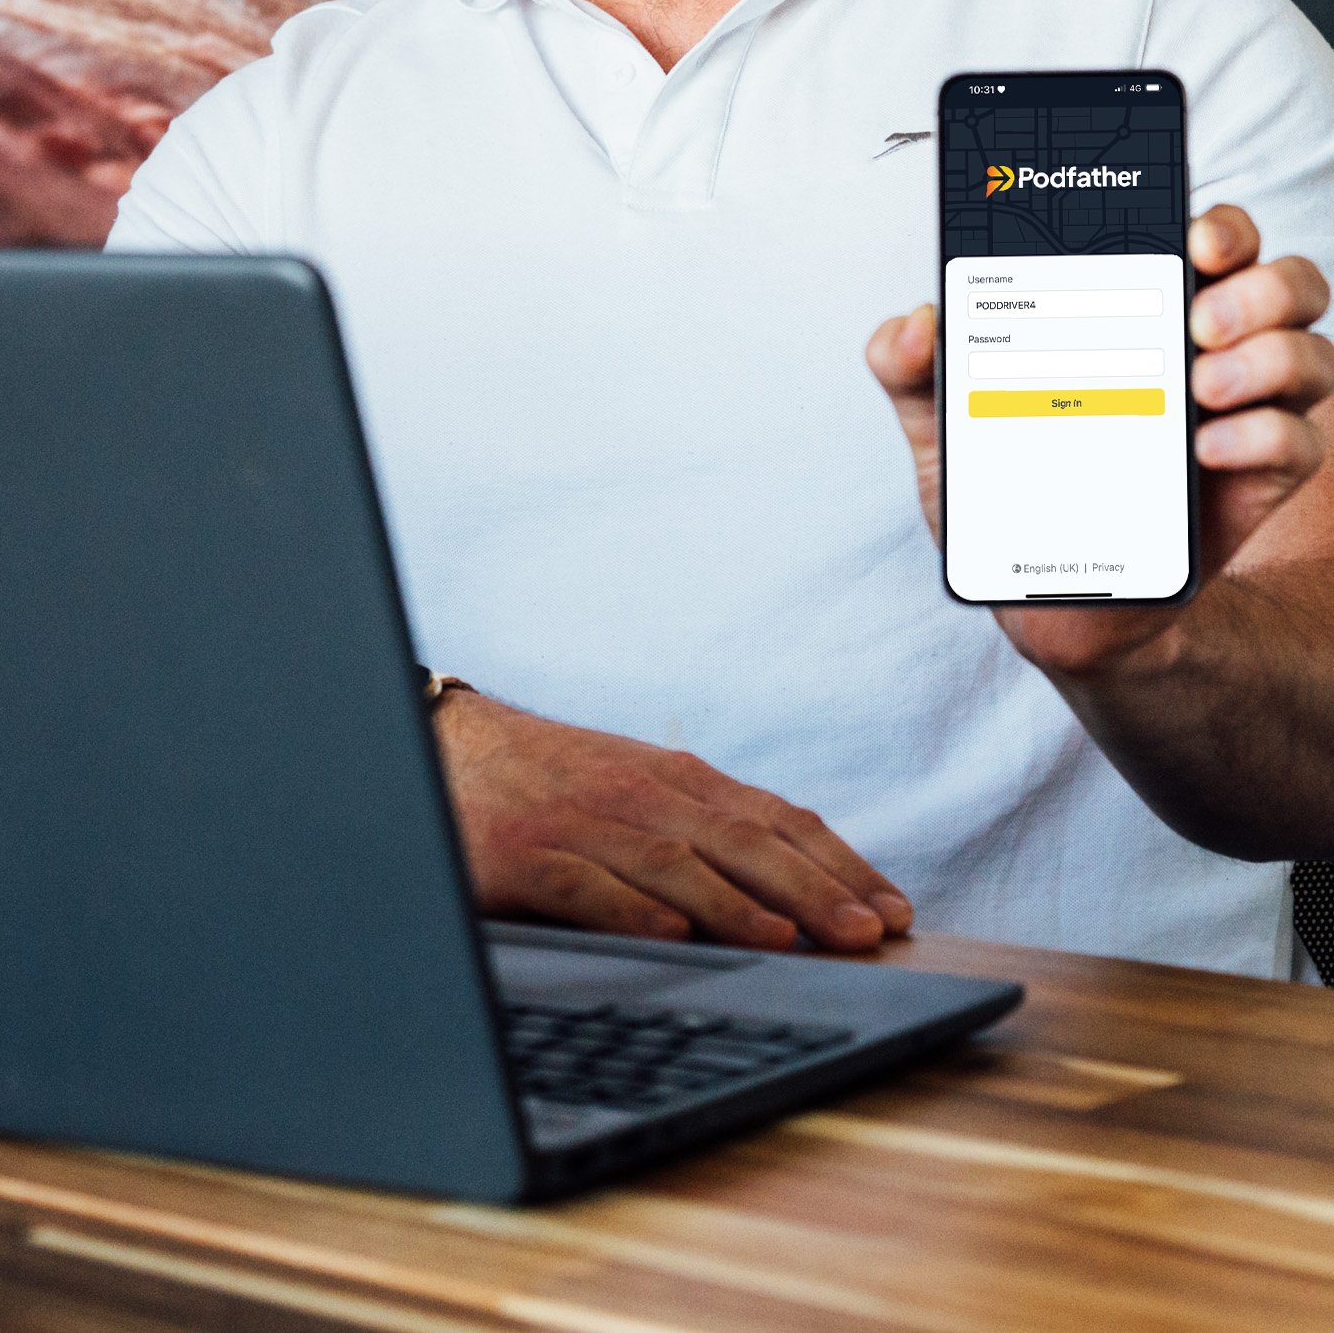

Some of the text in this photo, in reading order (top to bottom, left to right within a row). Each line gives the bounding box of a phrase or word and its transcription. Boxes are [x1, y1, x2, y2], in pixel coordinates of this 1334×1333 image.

[968, 84, 1142, 95] 10:31 4G
[1017, 165, 1142, 189] Podfather
[967, 275, 1014, 285] Username
[975, 300, 1036, 311] PODDRIVER4
[968, 334, 1011, 344] Password
[1051, 398, 1071, 410] Sign
[1023, 563, 1057, 575] English
[1059, 563, 1079, 575] (UK)
[1092, 562, 1125, 574] Privacy
